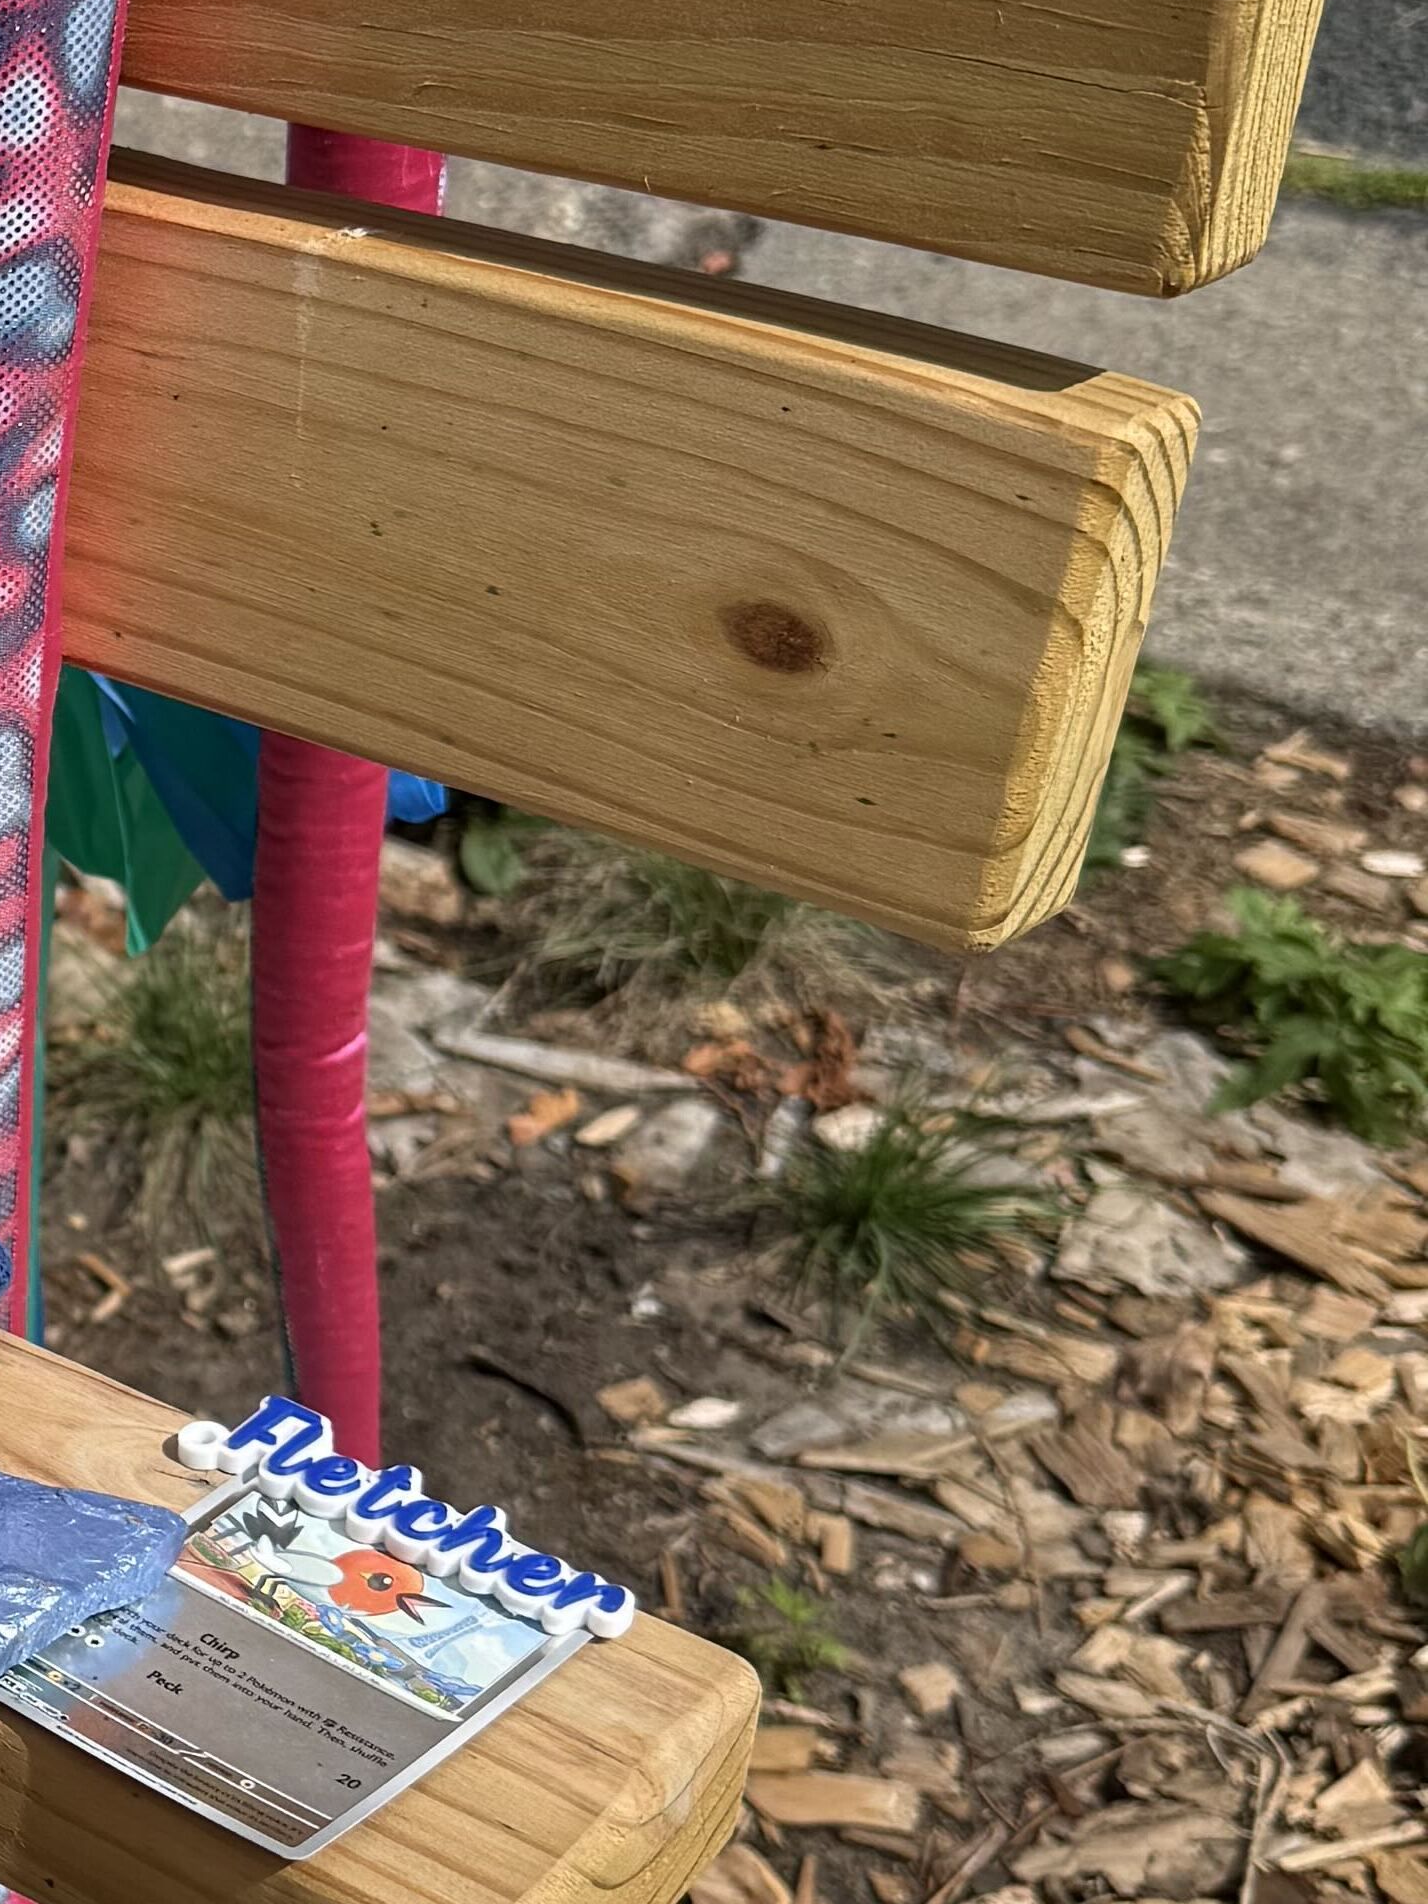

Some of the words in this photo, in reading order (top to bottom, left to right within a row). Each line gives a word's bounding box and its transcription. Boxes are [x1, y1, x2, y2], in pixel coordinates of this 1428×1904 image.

[226, 1395, 627, 1614] Fletcher
[199, 1633, 241, 1660] Chirp
[146, 1670, 185, 1695] Peck
[160, 1642, 182, 1656] and
[180, 1654, 202, 1667] put
[203, 1665, 231, 1684] them
[231, 1681, 254, 1697] into
[254, 1694, 284, 1711] your
[348, 1745, 388, 1768] shuffle
[166, 1633, 191, 1648] deck
[192, 1645, 208, 1657] for
[209, 1656, 223, 1668] up
[223, 1664, 237, 1674] to
[237, 1671, 247, 1679] 2
[246, 1675, 295, 1707] Pokémon
[297, 1704, 322, 1721] with
[334, 1773, 362, 1790] 20
